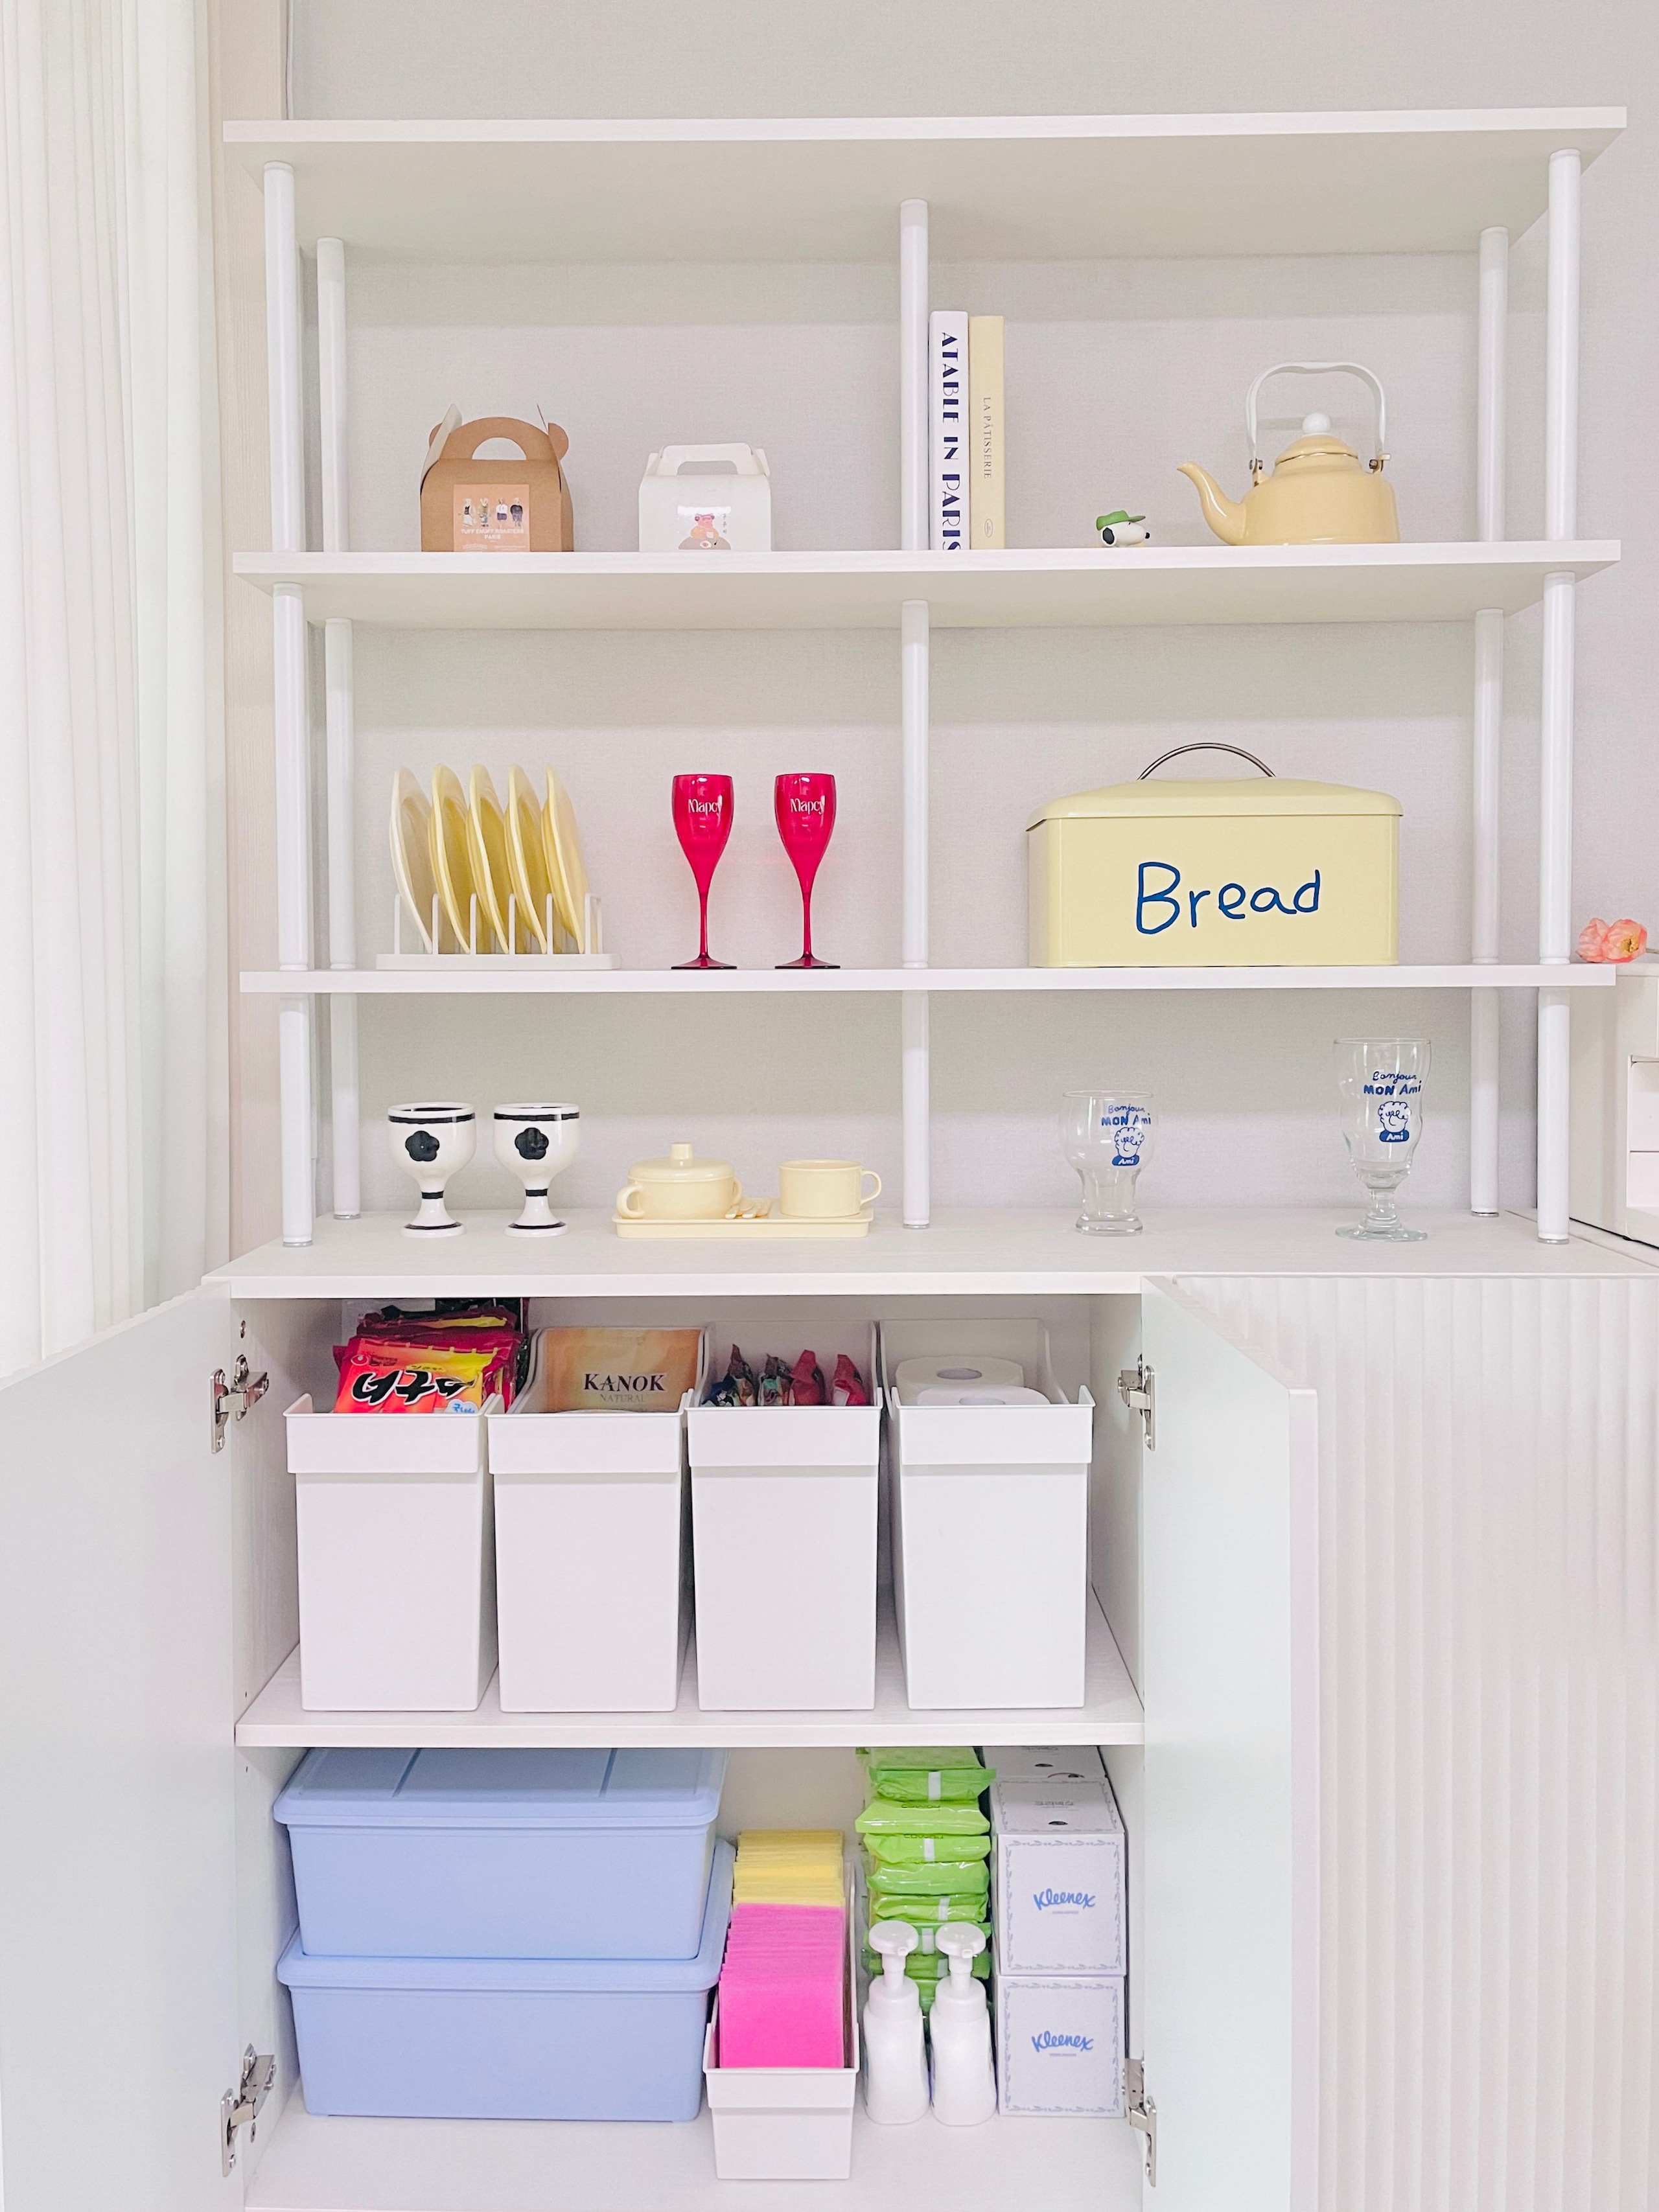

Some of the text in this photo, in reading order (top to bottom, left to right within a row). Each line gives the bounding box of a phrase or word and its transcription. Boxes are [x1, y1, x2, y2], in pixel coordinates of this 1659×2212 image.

[944, 436, 959, 460] IN
[983, 397, 993, 479] LA PÂTISSERIE
[942, 474, 961, 550] PARIS
[1136, 861, 1321, 935] Bread
[1363, 1080, 1422, 1095] MON Ami
[1372, 1070, 1417, 1084] Bonjour
[1101, 1112, 1152, 1126] MON Ami
[1108, 1103, 1146, 1116] Bonjour
[1386, 1132, 1404, 1141] Ami
[351, 1369, 478, 1406] 너구리
[583, 1373, 666, 1392] KANOK
[1033, 1888, 1096, 1911] Kleenex
[1031, 2030, 1094, 2053] Kleenex
